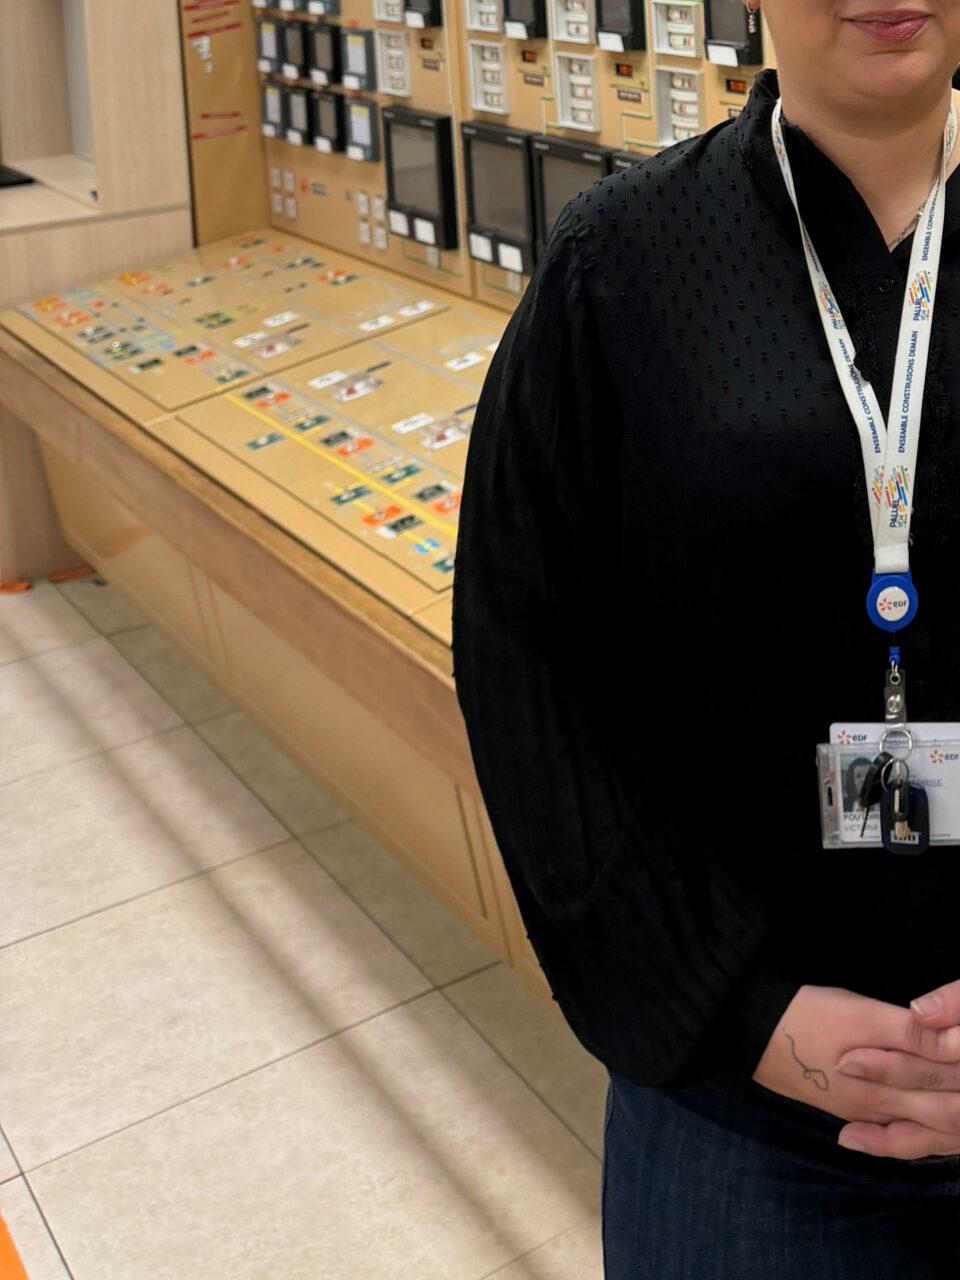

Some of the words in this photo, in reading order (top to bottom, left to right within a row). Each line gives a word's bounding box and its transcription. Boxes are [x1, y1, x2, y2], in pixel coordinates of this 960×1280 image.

[909, 331, 918, 357] DEMAIN
[902, 358, 915, 413] CONSTRUISONS
[866, 417, 881, 454] ENSEMBLE
[898, 415, 908, 453] ENSEMBLE
[889, 499, 900, 528] PALUEL
